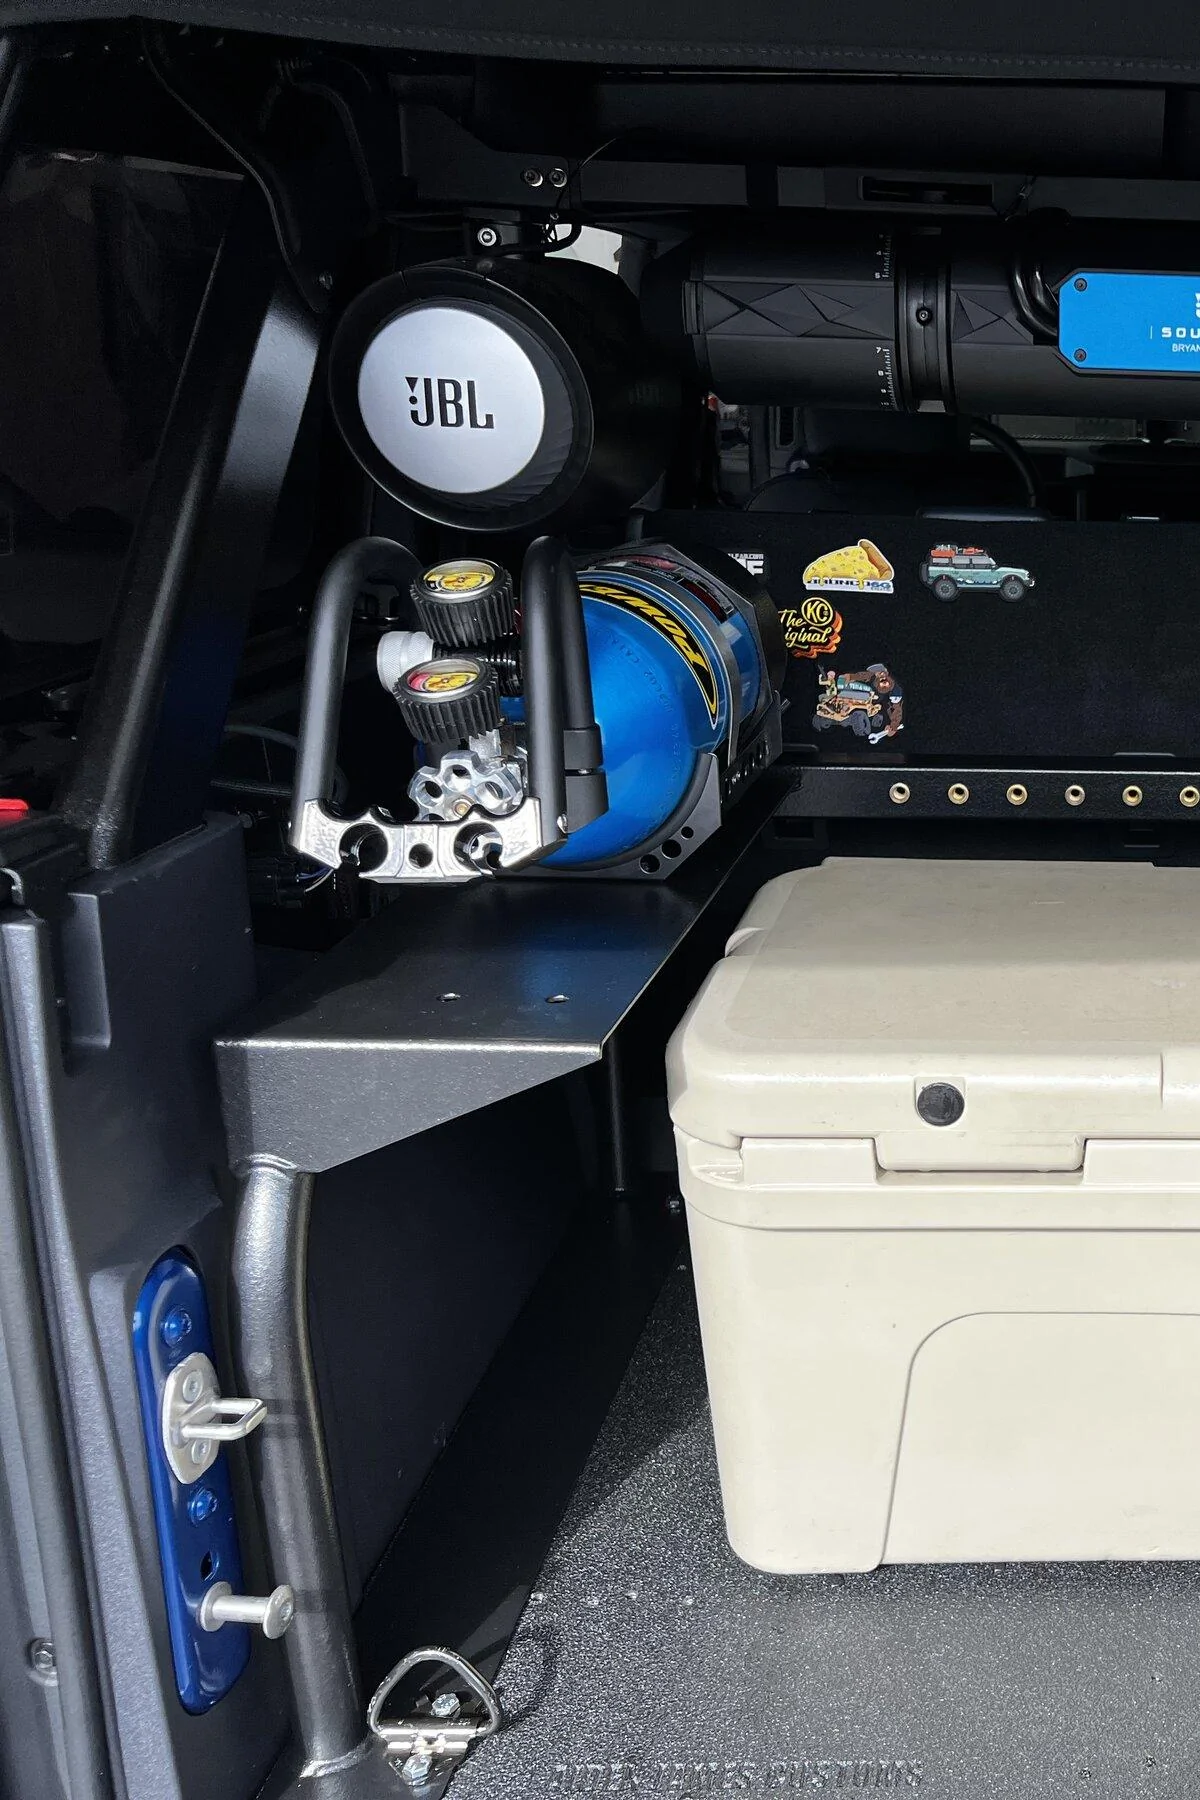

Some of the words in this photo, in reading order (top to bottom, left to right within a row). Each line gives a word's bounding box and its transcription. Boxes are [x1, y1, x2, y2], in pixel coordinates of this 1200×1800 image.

[404, 376, 495, 430] JBL
[778, 609, 807, 628] The
[806, 600, 829, 624] KC
[784, 626, 833, 648] iginal
